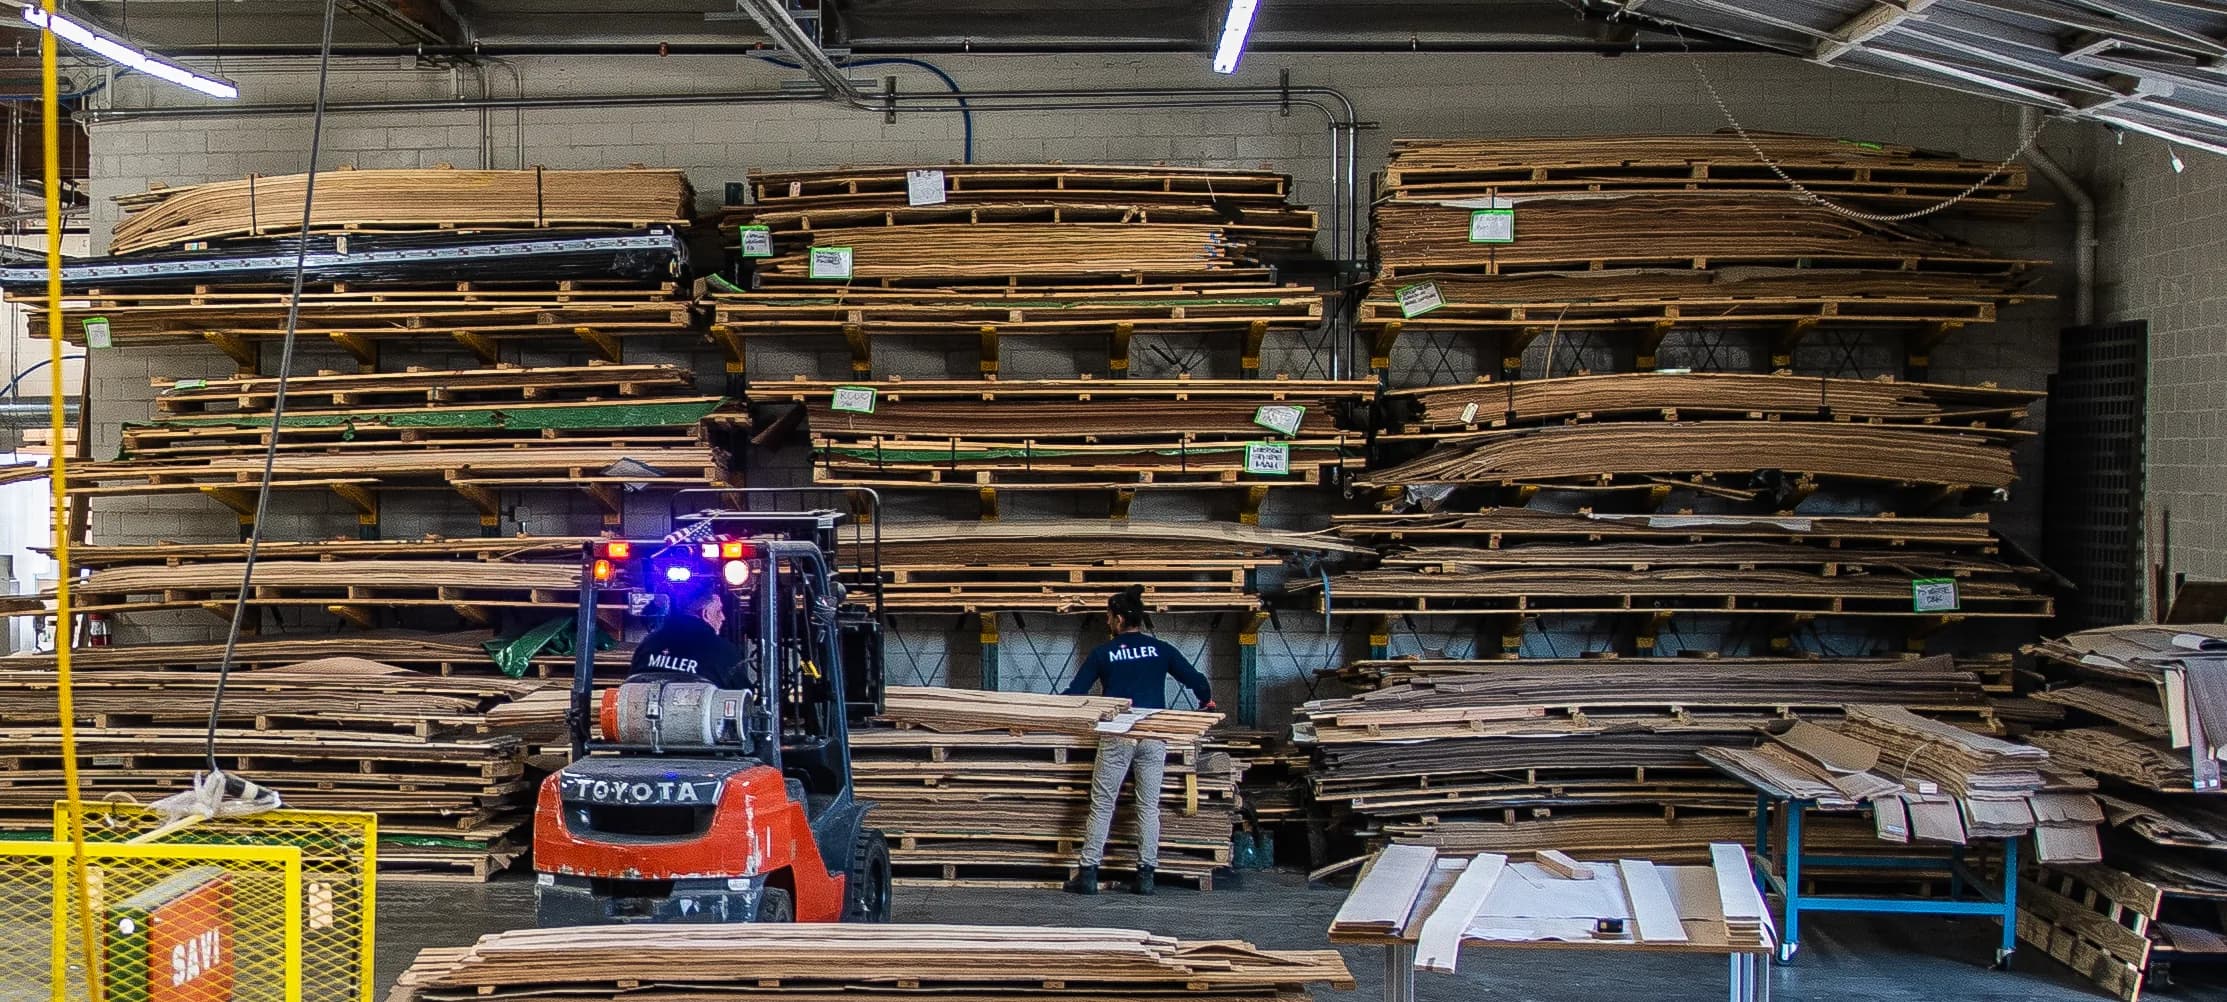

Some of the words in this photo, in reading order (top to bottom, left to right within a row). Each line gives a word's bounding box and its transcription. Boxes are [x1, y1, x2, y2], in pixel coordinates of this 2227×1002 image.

[648, 652, 698, 674] MILLER
[1108, 645, 1159, 662] MILLER
[575, 778, 699, 804] TOYOTA
